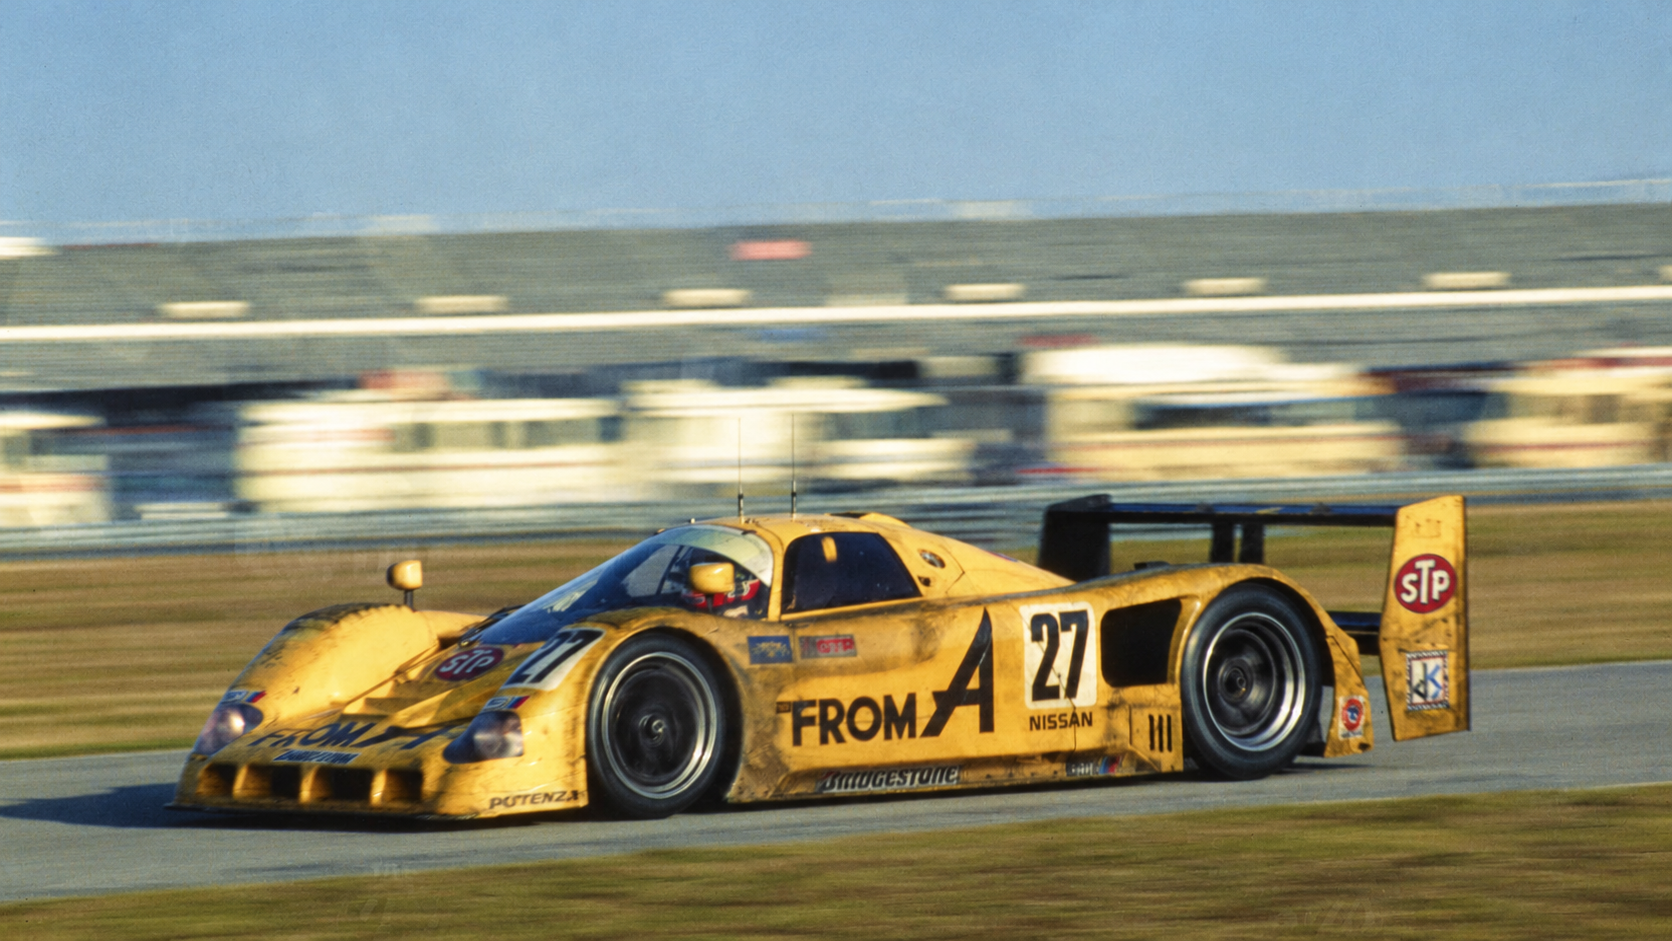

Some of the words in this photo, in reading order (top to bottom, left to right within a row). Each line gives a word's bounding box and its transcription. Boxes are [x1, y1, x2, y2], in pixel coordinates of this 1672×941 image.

[1400, 559, 1450, 604] STP
[439, 649, 495, 675] STP
[504, 628, 606, 687] 27
[1030, 609, 1089, 702] 27
[791, 692, 917, 748] FROM
[920, 606, 995, 738] A
[247, 721, 378, 748] FROM
[1029, 711, 1093, 732] NISSAN
[820, 765, 959, 793] BRIDGESTONE
[489, 789, 579, 810] POTENZA
